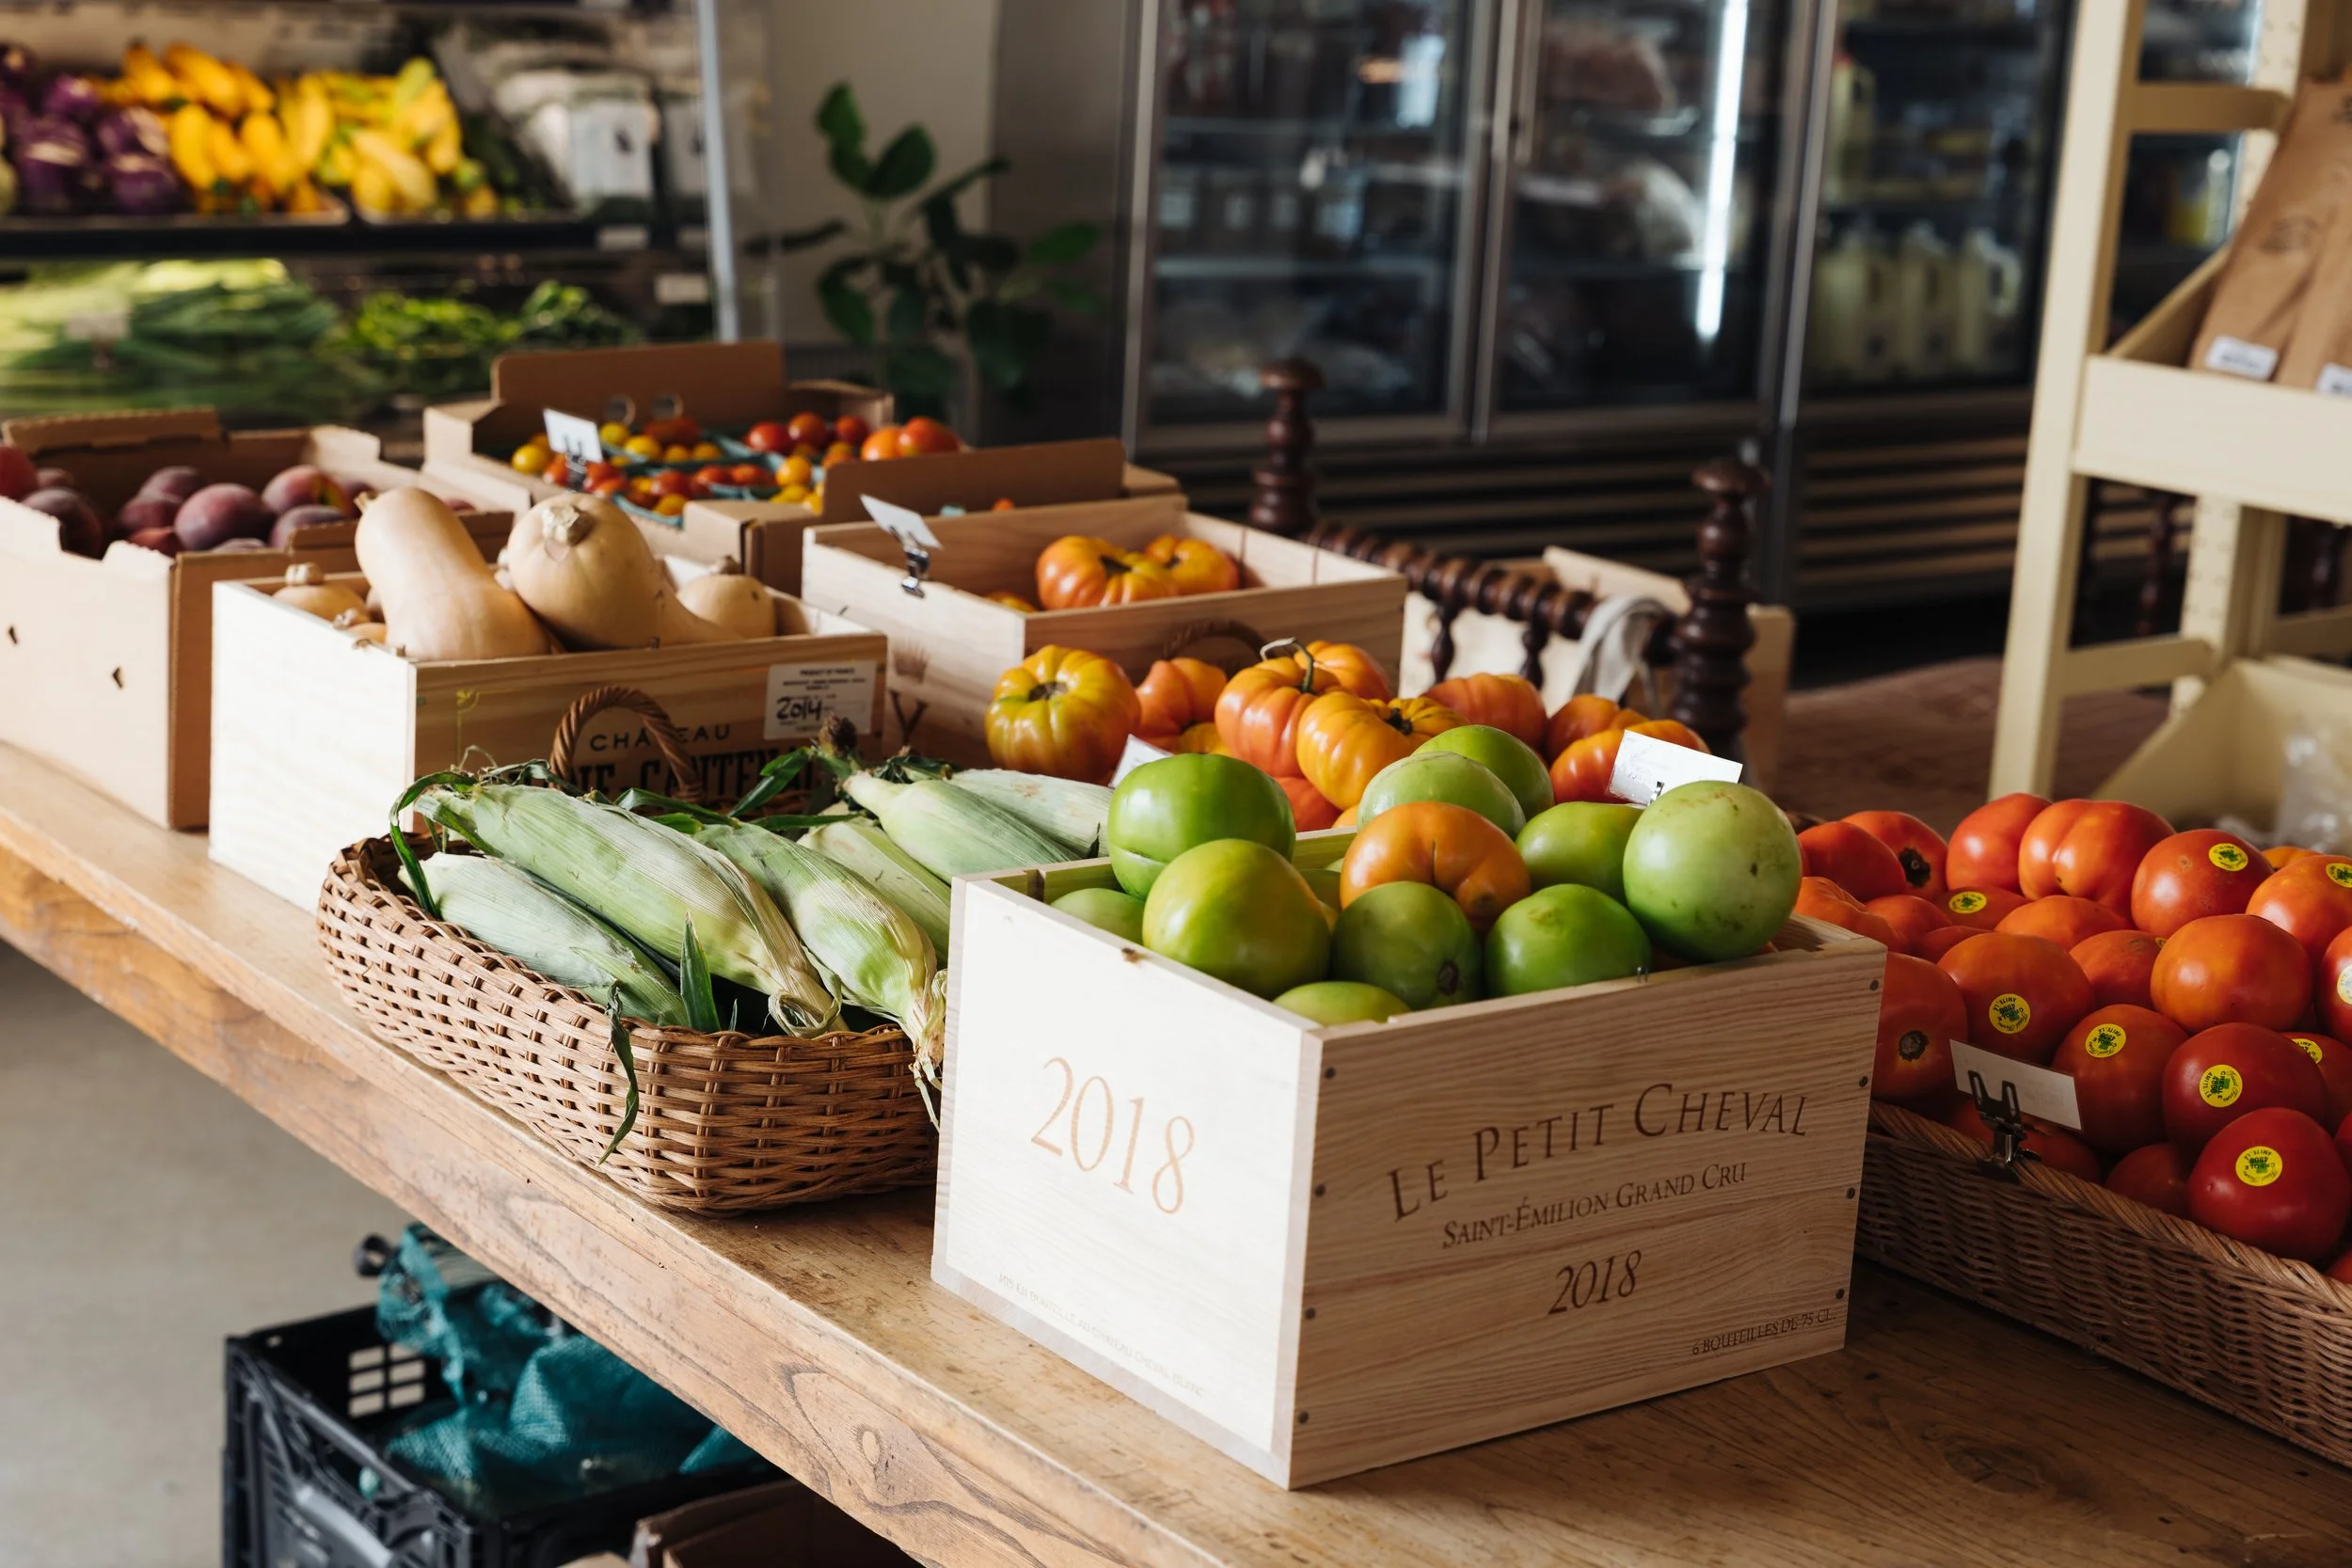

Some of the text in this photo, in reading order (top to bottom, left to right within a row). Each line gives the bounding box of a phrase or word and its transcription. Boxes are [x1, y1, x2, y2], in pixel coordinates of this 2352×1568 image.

[776, 696, 822, 721] 2014
[1997, 1007, 2024, 1022] CREOLE
[1031, 1056, 1196, 1214] 2018
[1387, 1082, 1810, 1222] LE PETIT CHEVAL
[1441, 1162, 1747, 1249] SAINT-ÉMILION GRAND CRU
[1548, 1250, 1643, 1316] 2018
[1692, 1343, 1700, 1355] 6
[1702, 1322, 1779, 1354] BOUTEILLES
[1781, 1318, 1798, 1333] DE
[1802, 1312, 1815, 1328] 75
